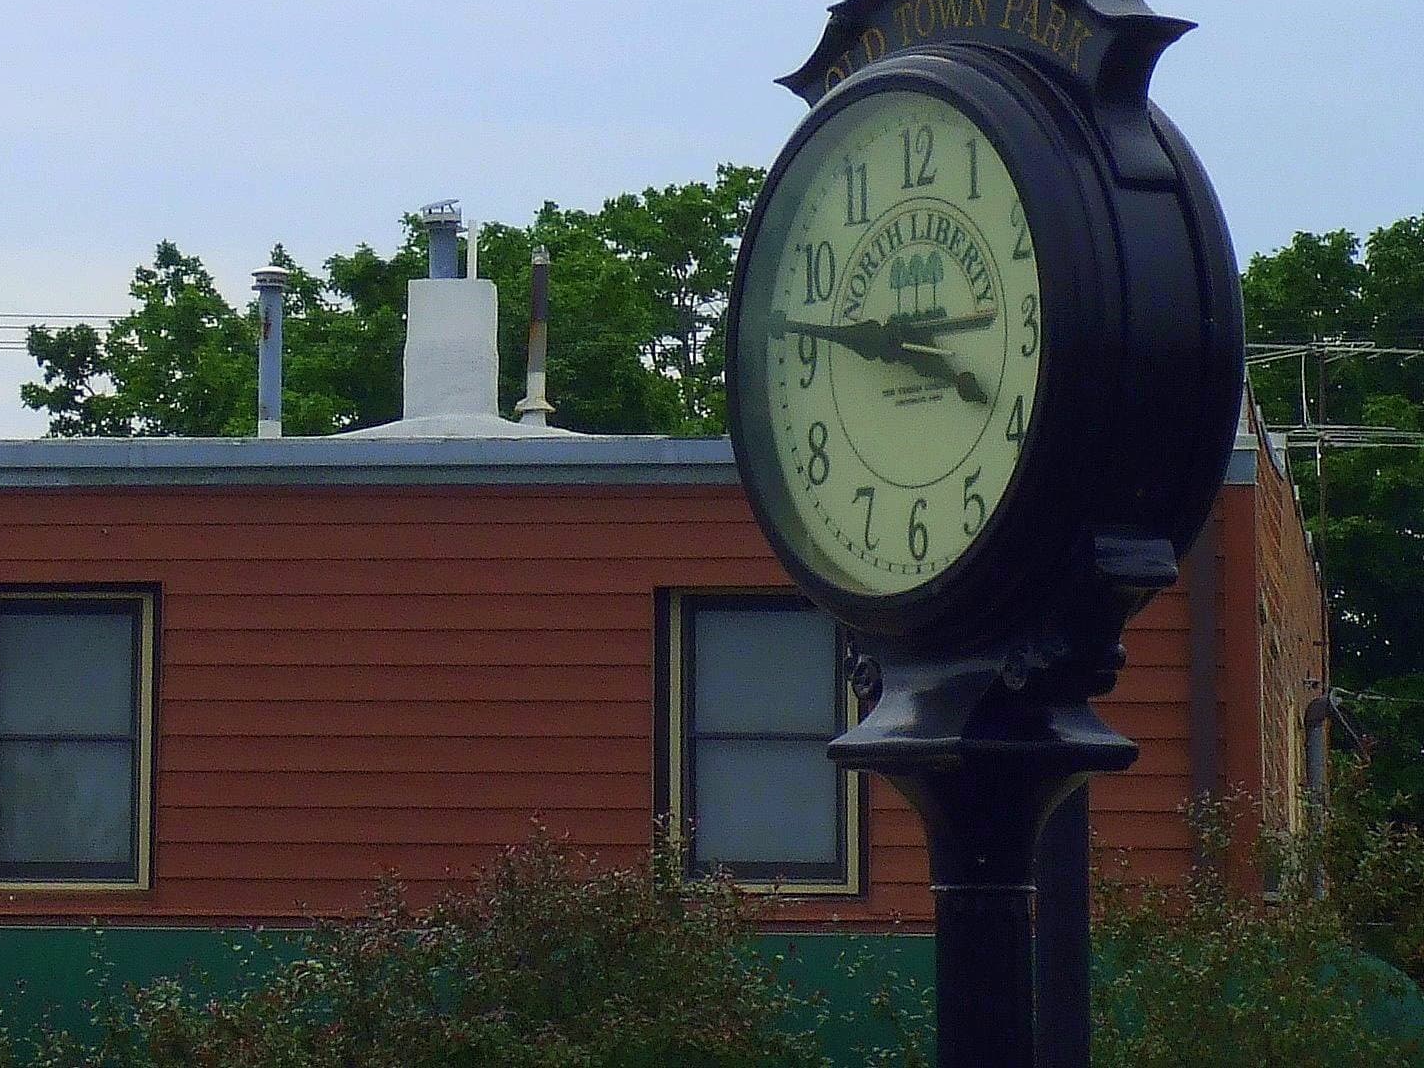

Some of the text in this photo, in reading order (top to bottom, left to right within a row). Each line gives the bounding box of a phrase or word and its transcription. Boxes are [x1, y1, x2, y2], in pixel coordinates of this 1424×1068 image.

[900, 124, 937, 189] 12
[966, 138, 982, 199] 1
[842, 155, 871, 226] 11
[1009, 199, 1033, 260] 2
[804, 240, 836, 304] 10
[843, 213, 995, 322] NORTH LIBERTY
[1020, 293, 1039, 358] 3
[798, 331, 817, 389] 9
[808, 421, 829, 485] 8
[1005, 395, 1027, 448] 4
[852, 487, 879, 550] 7
[908, 498, 928, 561] 6
[963, 466, 985, 537] 5
